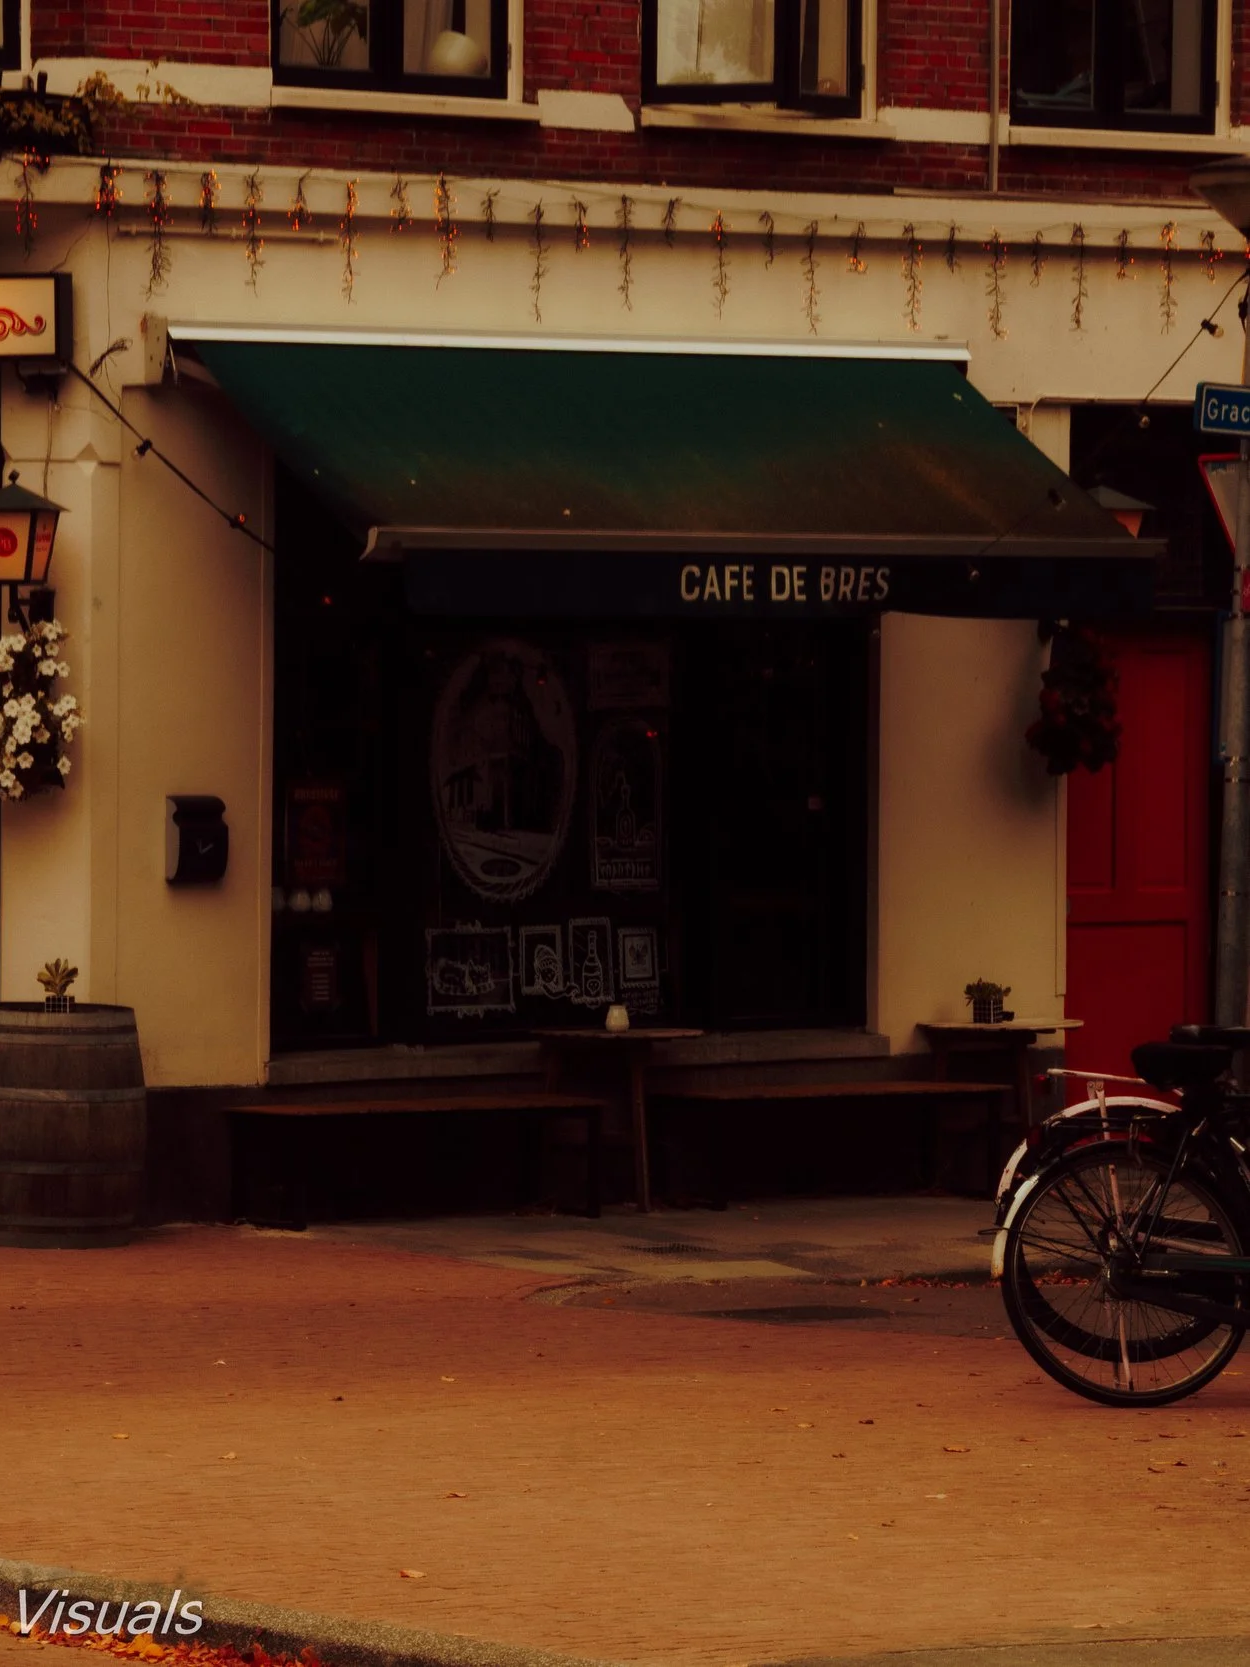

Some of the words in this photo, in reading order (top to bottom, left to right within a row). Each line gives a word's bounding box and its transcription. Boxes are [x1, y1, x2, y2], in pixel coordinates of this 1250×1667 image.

[680, 563, 755, 600] CAFE
[770, 565, 807, 600] DE
[819, 565, 891, 601] BRES
